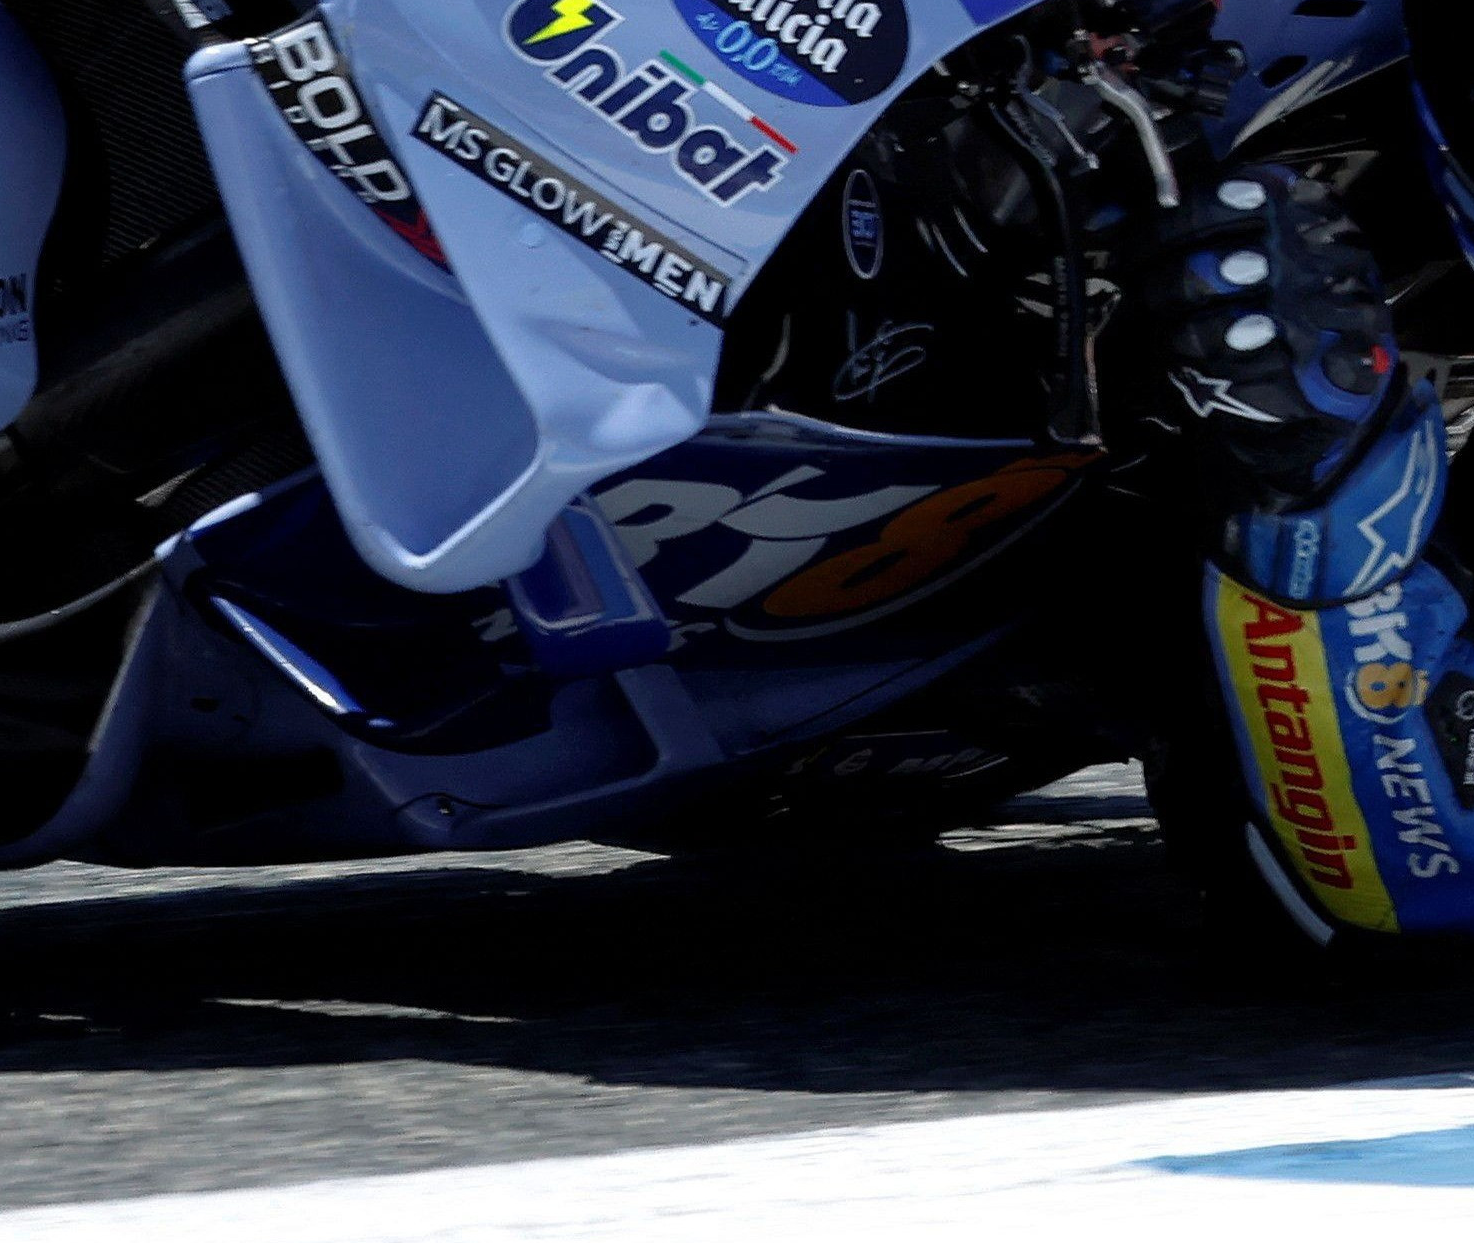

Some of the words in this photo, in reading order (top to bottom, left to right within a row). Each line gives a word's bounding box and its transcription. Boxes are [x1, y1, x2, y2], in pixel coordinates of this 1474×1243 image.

[271, 21, 412, 202] BOLD
[418, 97, 490, 160] MS
[483, 146, 614, 238] GLOW
[617, 229, 724, 313] MEN
[1344, 582, 1419, 716] BK8
[1242, 593, 1359, 890] Antangin
[1372, 732, 1461, 880] NEWS
